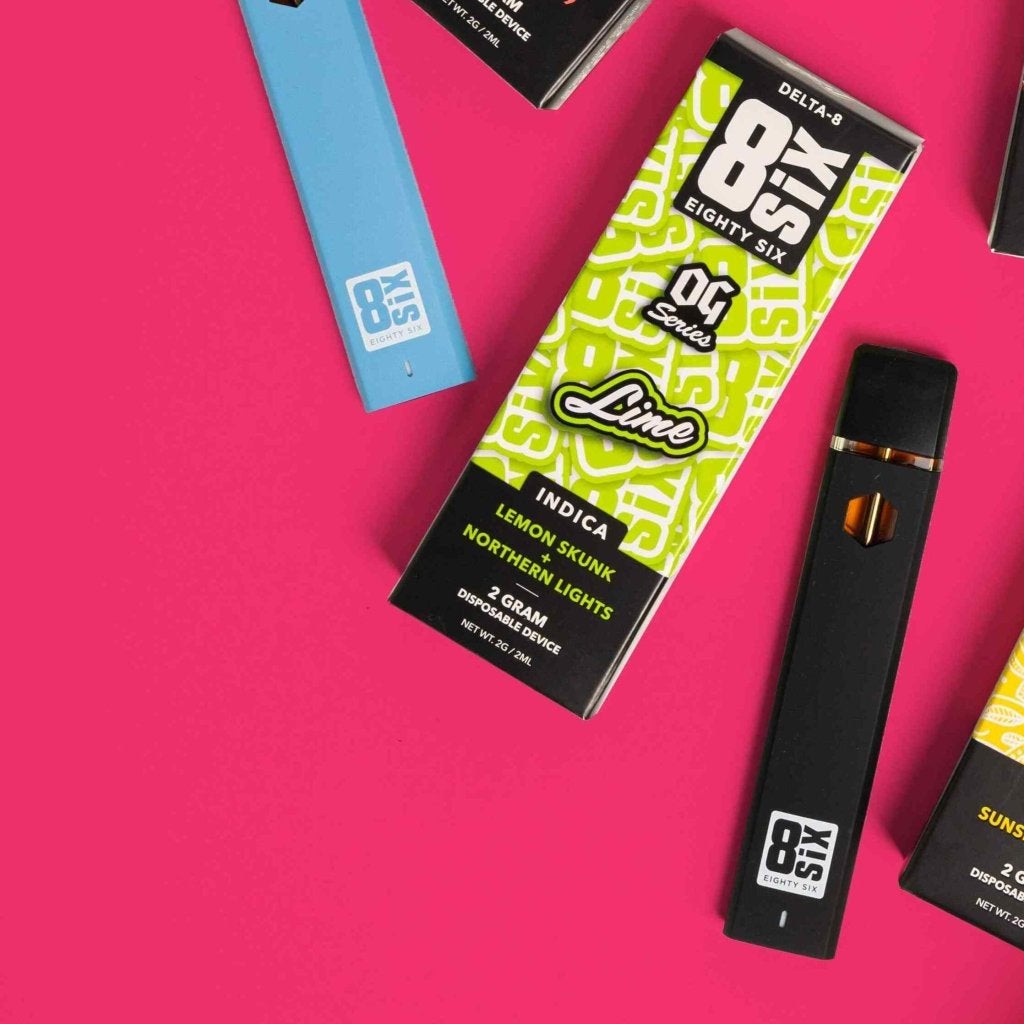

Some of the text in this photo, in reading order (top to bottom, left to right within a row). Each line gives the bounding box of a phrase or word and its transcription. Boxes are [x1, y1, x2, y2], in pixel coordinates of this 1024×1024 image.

[452, 2, 468, 18] WT.
[466, 15, 481, 29] 2G
[482, 29, 501, 49] 2ML
[495, 8, 532, 42] DEVICE
[777, 82, 843, 125] DELTA-8
[697, 98, 793, 212] 8
[683, 196, 753, 245] EIGHTY
[754, 238, 786, 265] SIX
[353, 278, 392, 334] 8
[669, 267, 735, 325] OG
[370, 325, 422, 345] EIGHTY SIX
[647, 302, 711, 347] Series
[565, 384, 695, 444] Lime
[535, 487, 608, 540] INDICA
[495, 503, 617, 583] LEMON SKUNK
[462, 524, 614, 620] NORTHERN LIGHTS
[457, 588, 562, 655] DISPOSABLE DEVICE
[487, 586, 548, 628] 2 GRAM
[461, 618, 480, 633] NET
[479, 628, 495, 642] WT.
[495, 639, 508, 652] 2G
[514, 651, 533, 667] 2ML
[766, 818, 802, 874] 8
[1001, 863, 1014, 877] 2
[764, 875, 818, 892] EIGHTY SIX
[975, 898, 996, 914] NET
[994, 907, 1011, 922] WT.
